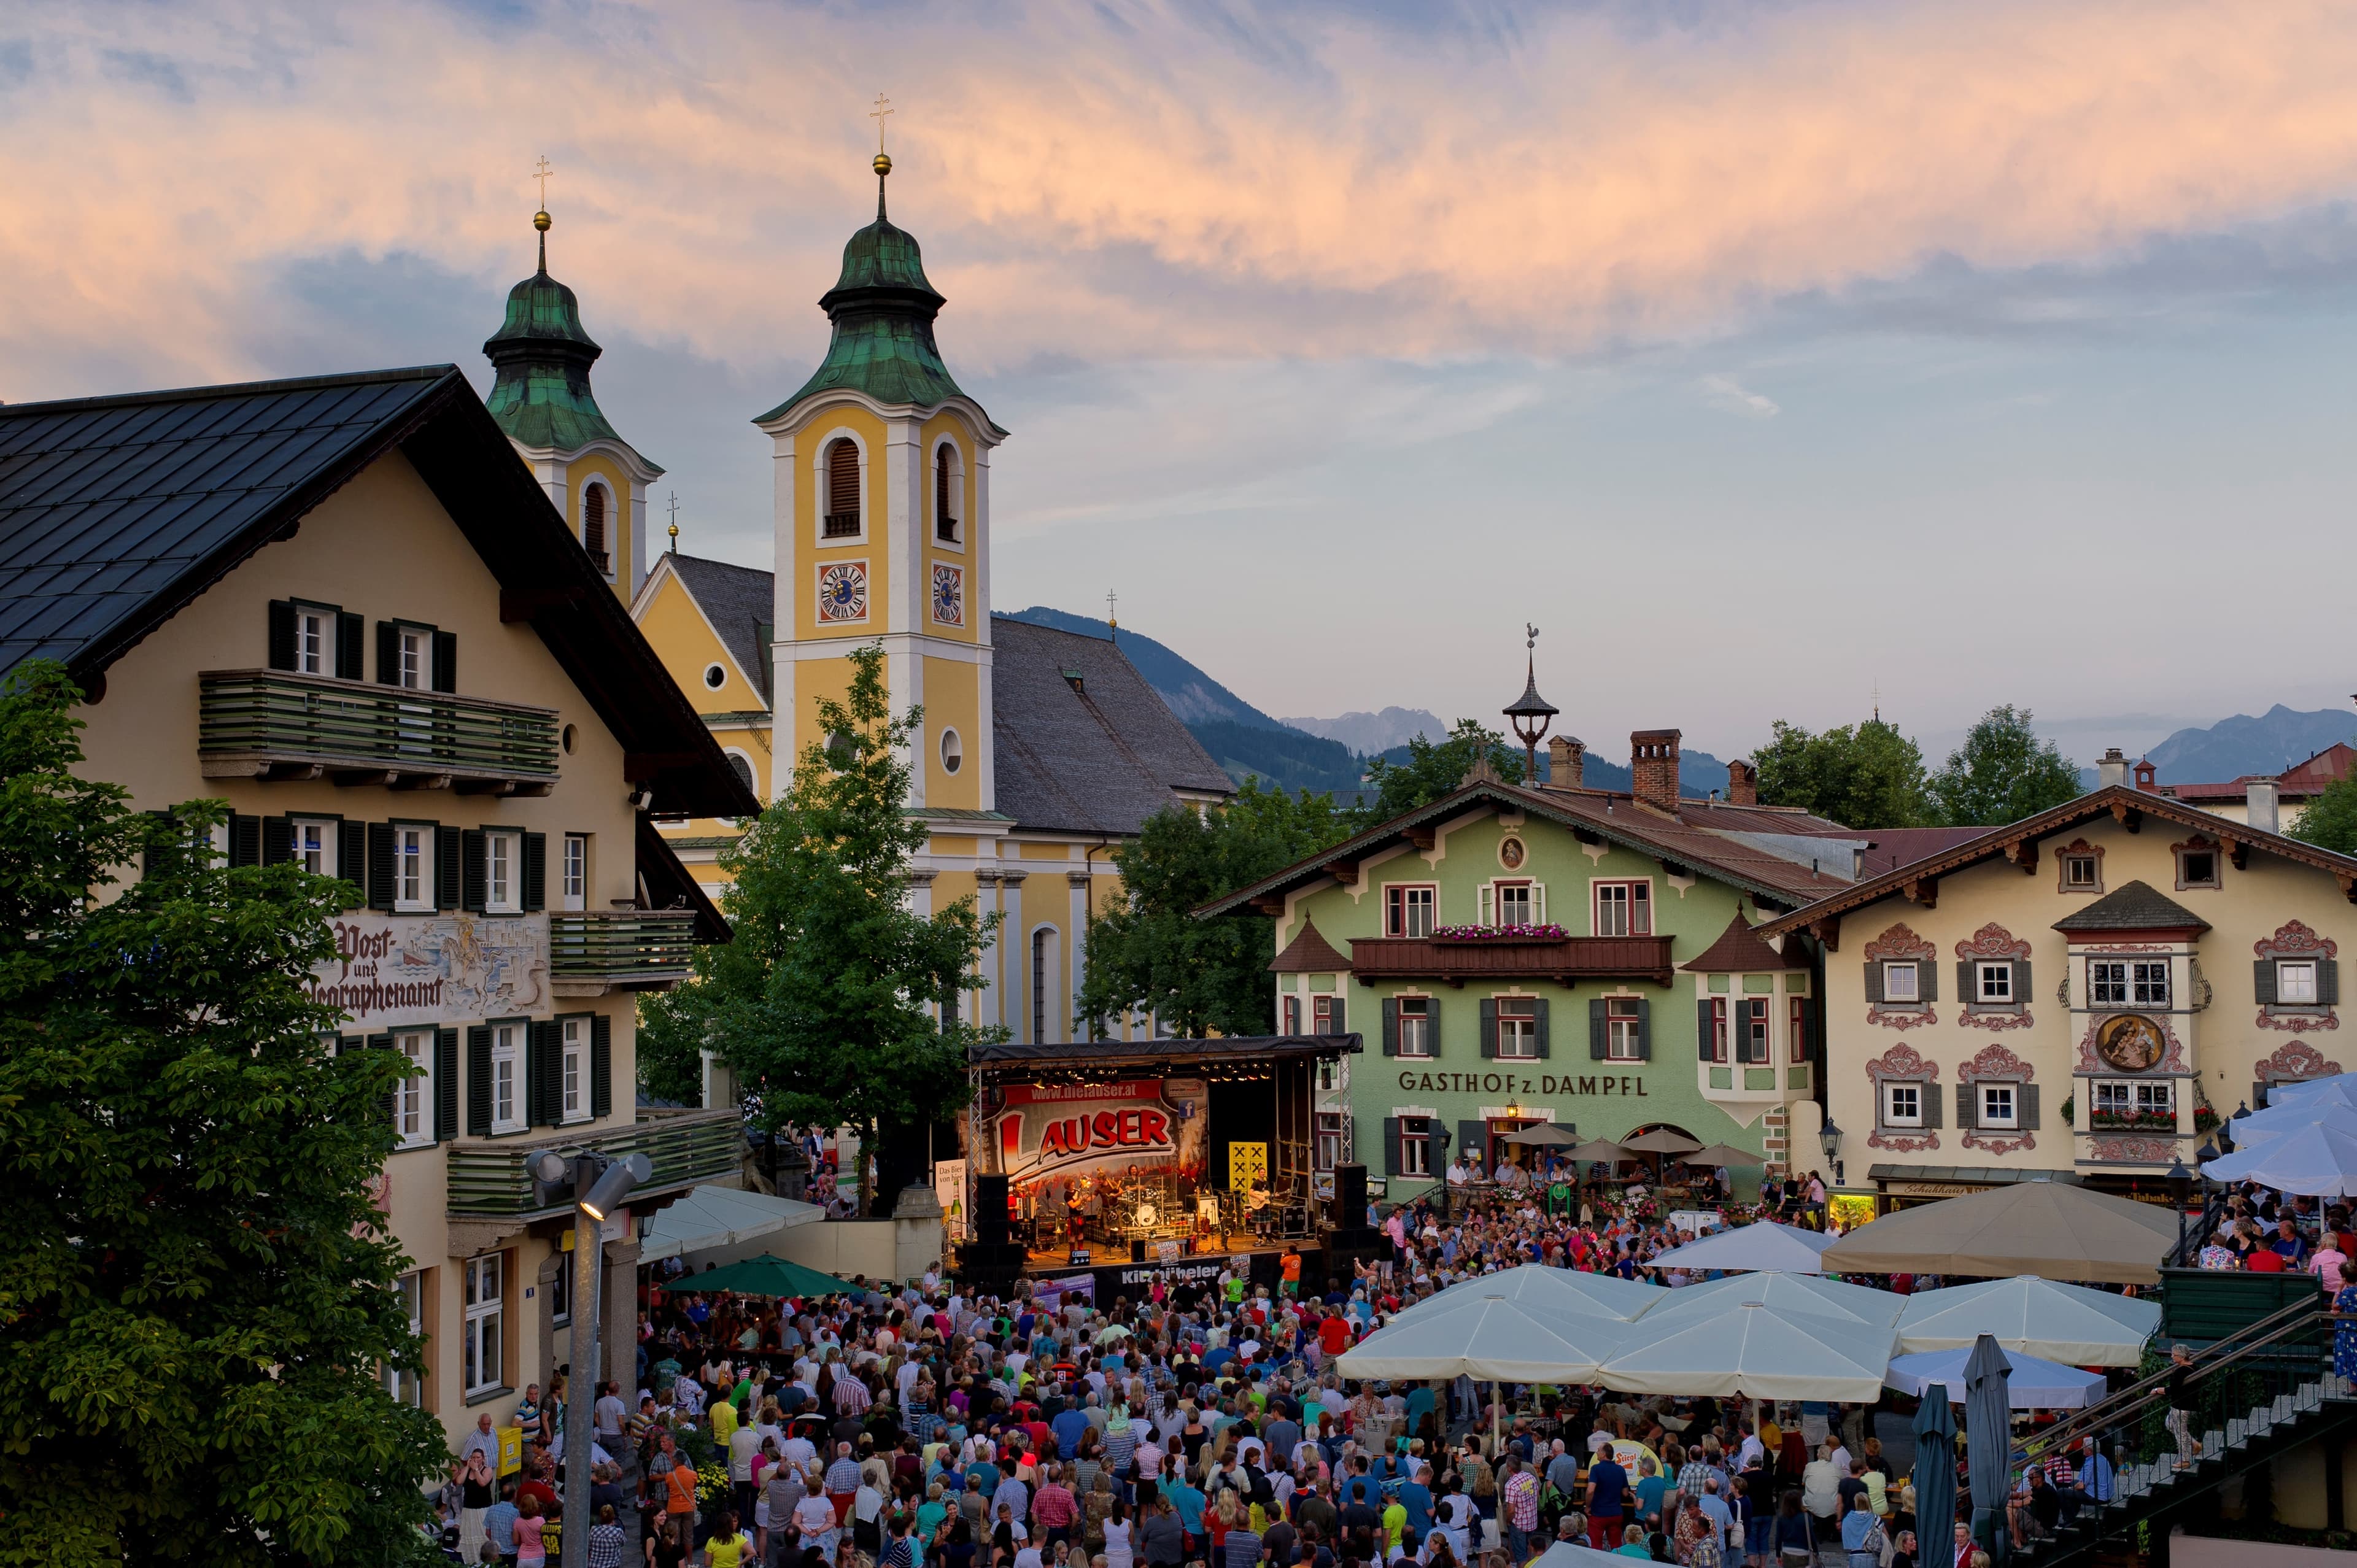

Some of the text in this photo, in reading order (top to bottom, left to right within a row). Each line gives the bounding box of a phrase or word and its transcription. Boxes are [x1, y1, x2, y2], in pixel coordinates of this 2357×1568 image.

[333, 921, 397, 984] Post-
[354, 960, 378, 977] und
[1031, 1084, 1136, 1100] www.dielauser.at
[1398, 1071, 1647, 1096] GASTHOF z. DAMPFL
[998, 1108, 1170, 1177] LAUSER
[1905, 1183, 1964, 1194] Schuhhaus
[1122, 1265, 1220, 1284] Kitzbüheler
[1616, 1452, 1637, 1464] Stiegl
